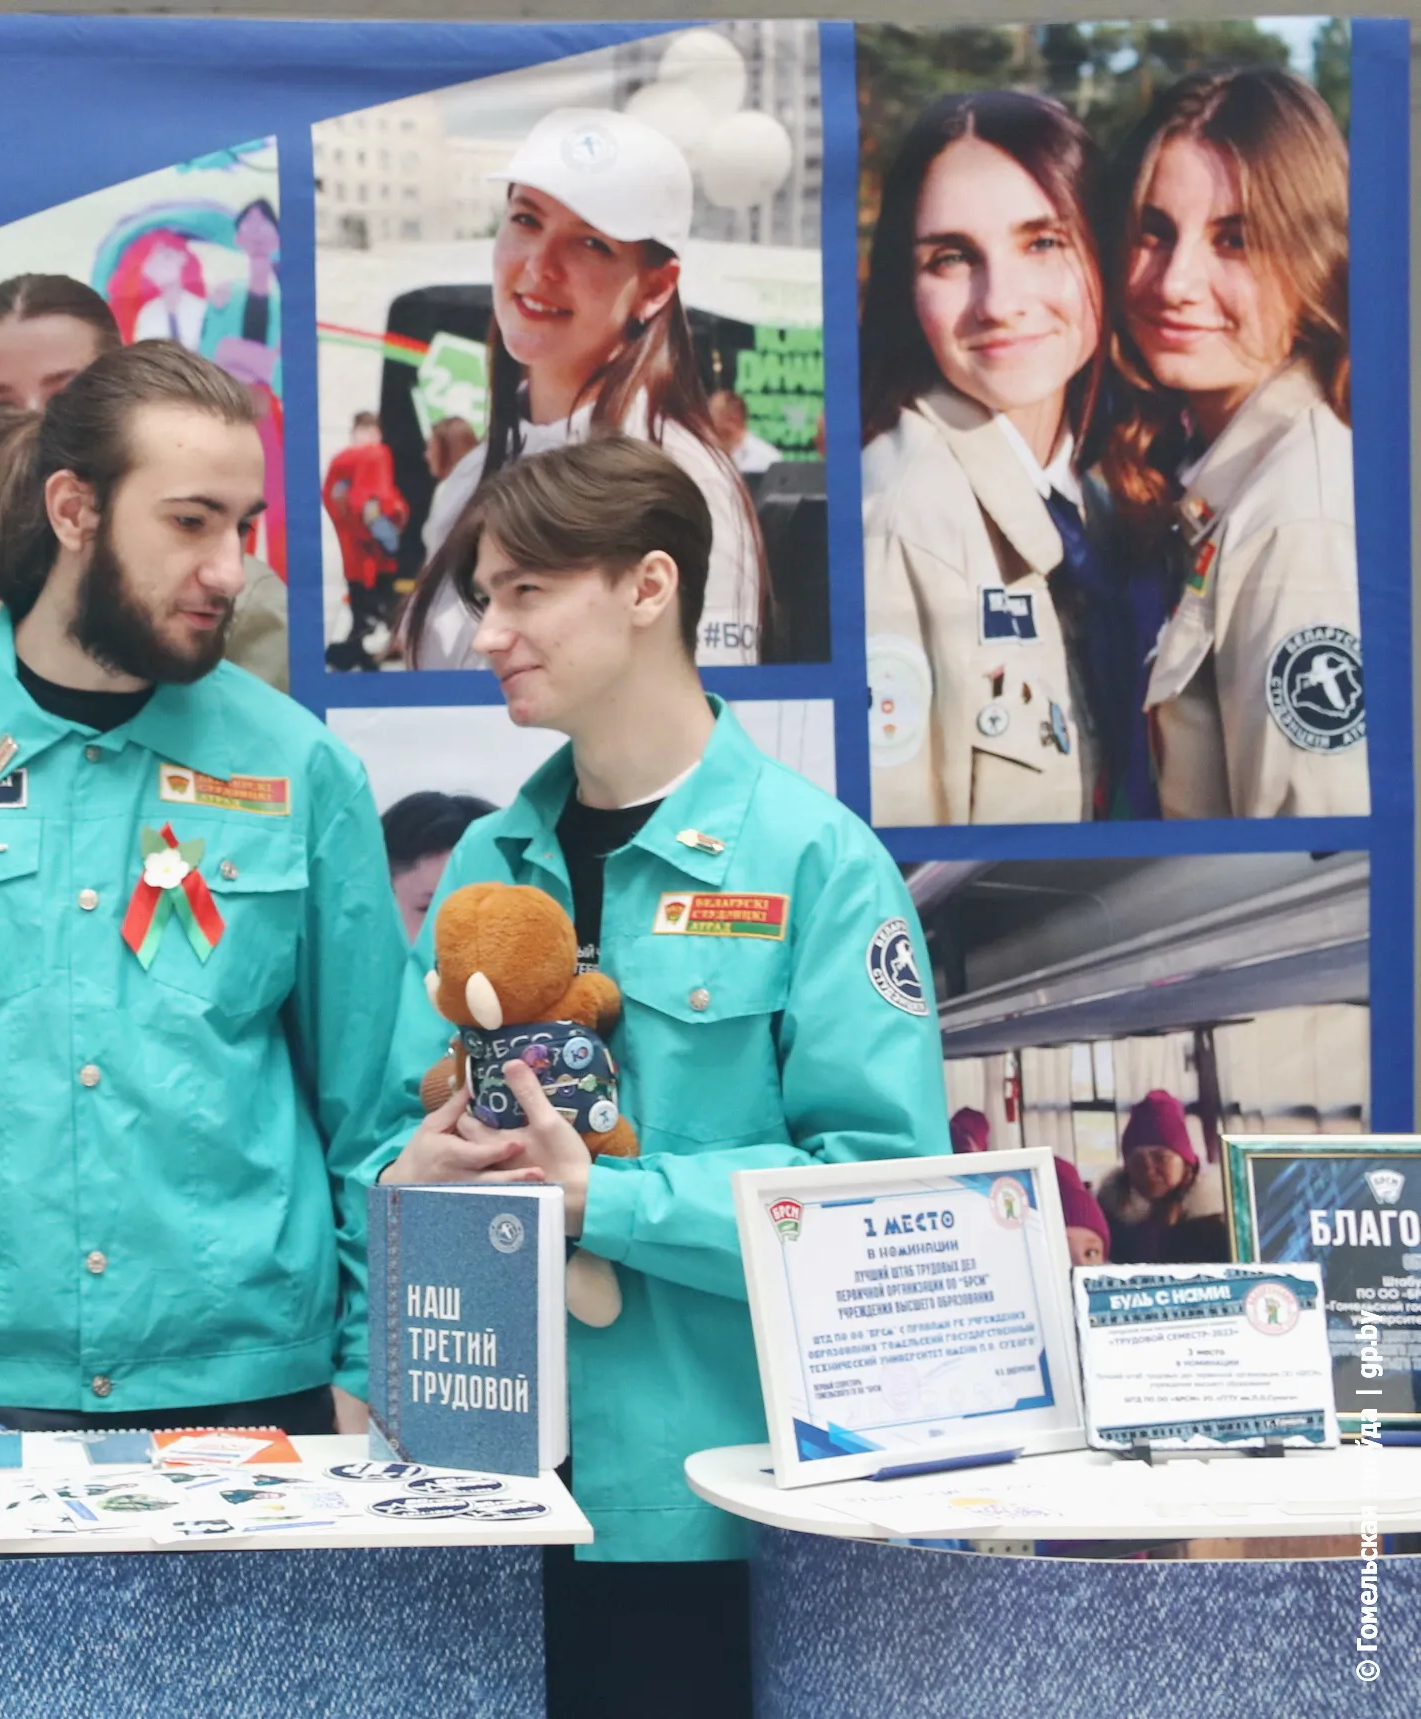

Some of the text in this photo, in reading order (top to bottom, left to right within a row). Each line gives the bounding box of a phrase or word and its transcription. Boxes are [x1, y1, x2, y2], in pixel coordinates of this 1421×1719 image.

[704, 621, 760, 650] #БС
[863, 1209, 956, 1238] 1 МЕСТО
[1309, 1208, 1421, 1248] БЛАГО
[880, 1238, 960, 1259] НОМИНАЦИИ
[917, 1259, 960, 1278] ТРУДОВЫХ
[407, 1284, 461, 1321] НАШ
[1109, 1293, 1153, 1311] БУДЬ
[1155, 1290, 1172, 1305] С
[407, 1327, 497, 1367] ТРЕТИЙ
[408, 1369, 529, 1413] ТРУДОВОЙ
